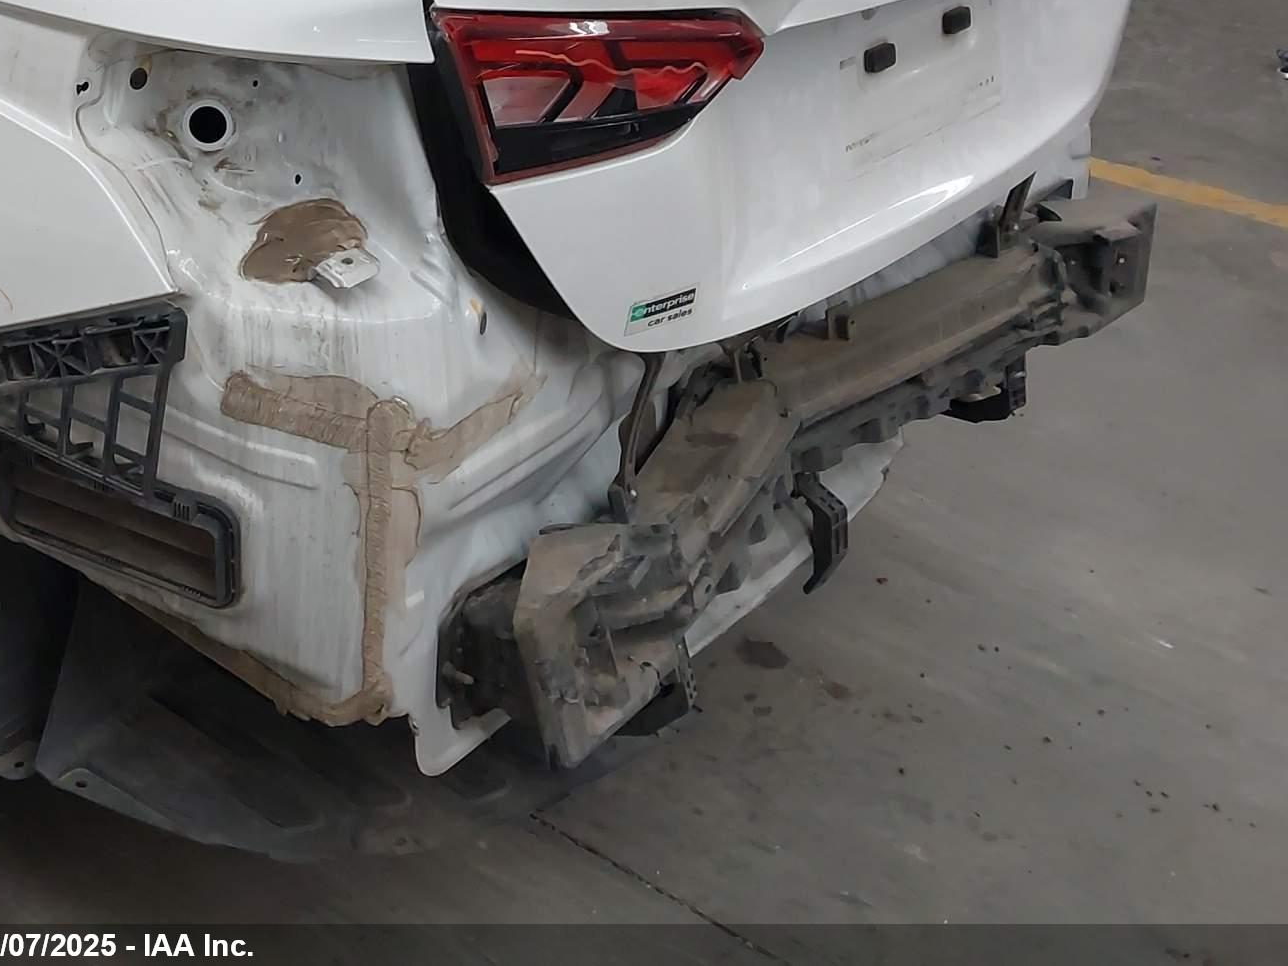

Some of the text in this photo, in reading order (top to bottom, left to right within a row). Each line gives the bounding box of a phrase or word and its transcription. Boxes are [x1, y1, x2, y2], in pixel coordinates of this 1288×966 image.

[632, 294, 695, 318] enterprise
[647, 308, 693, 327] car sales
